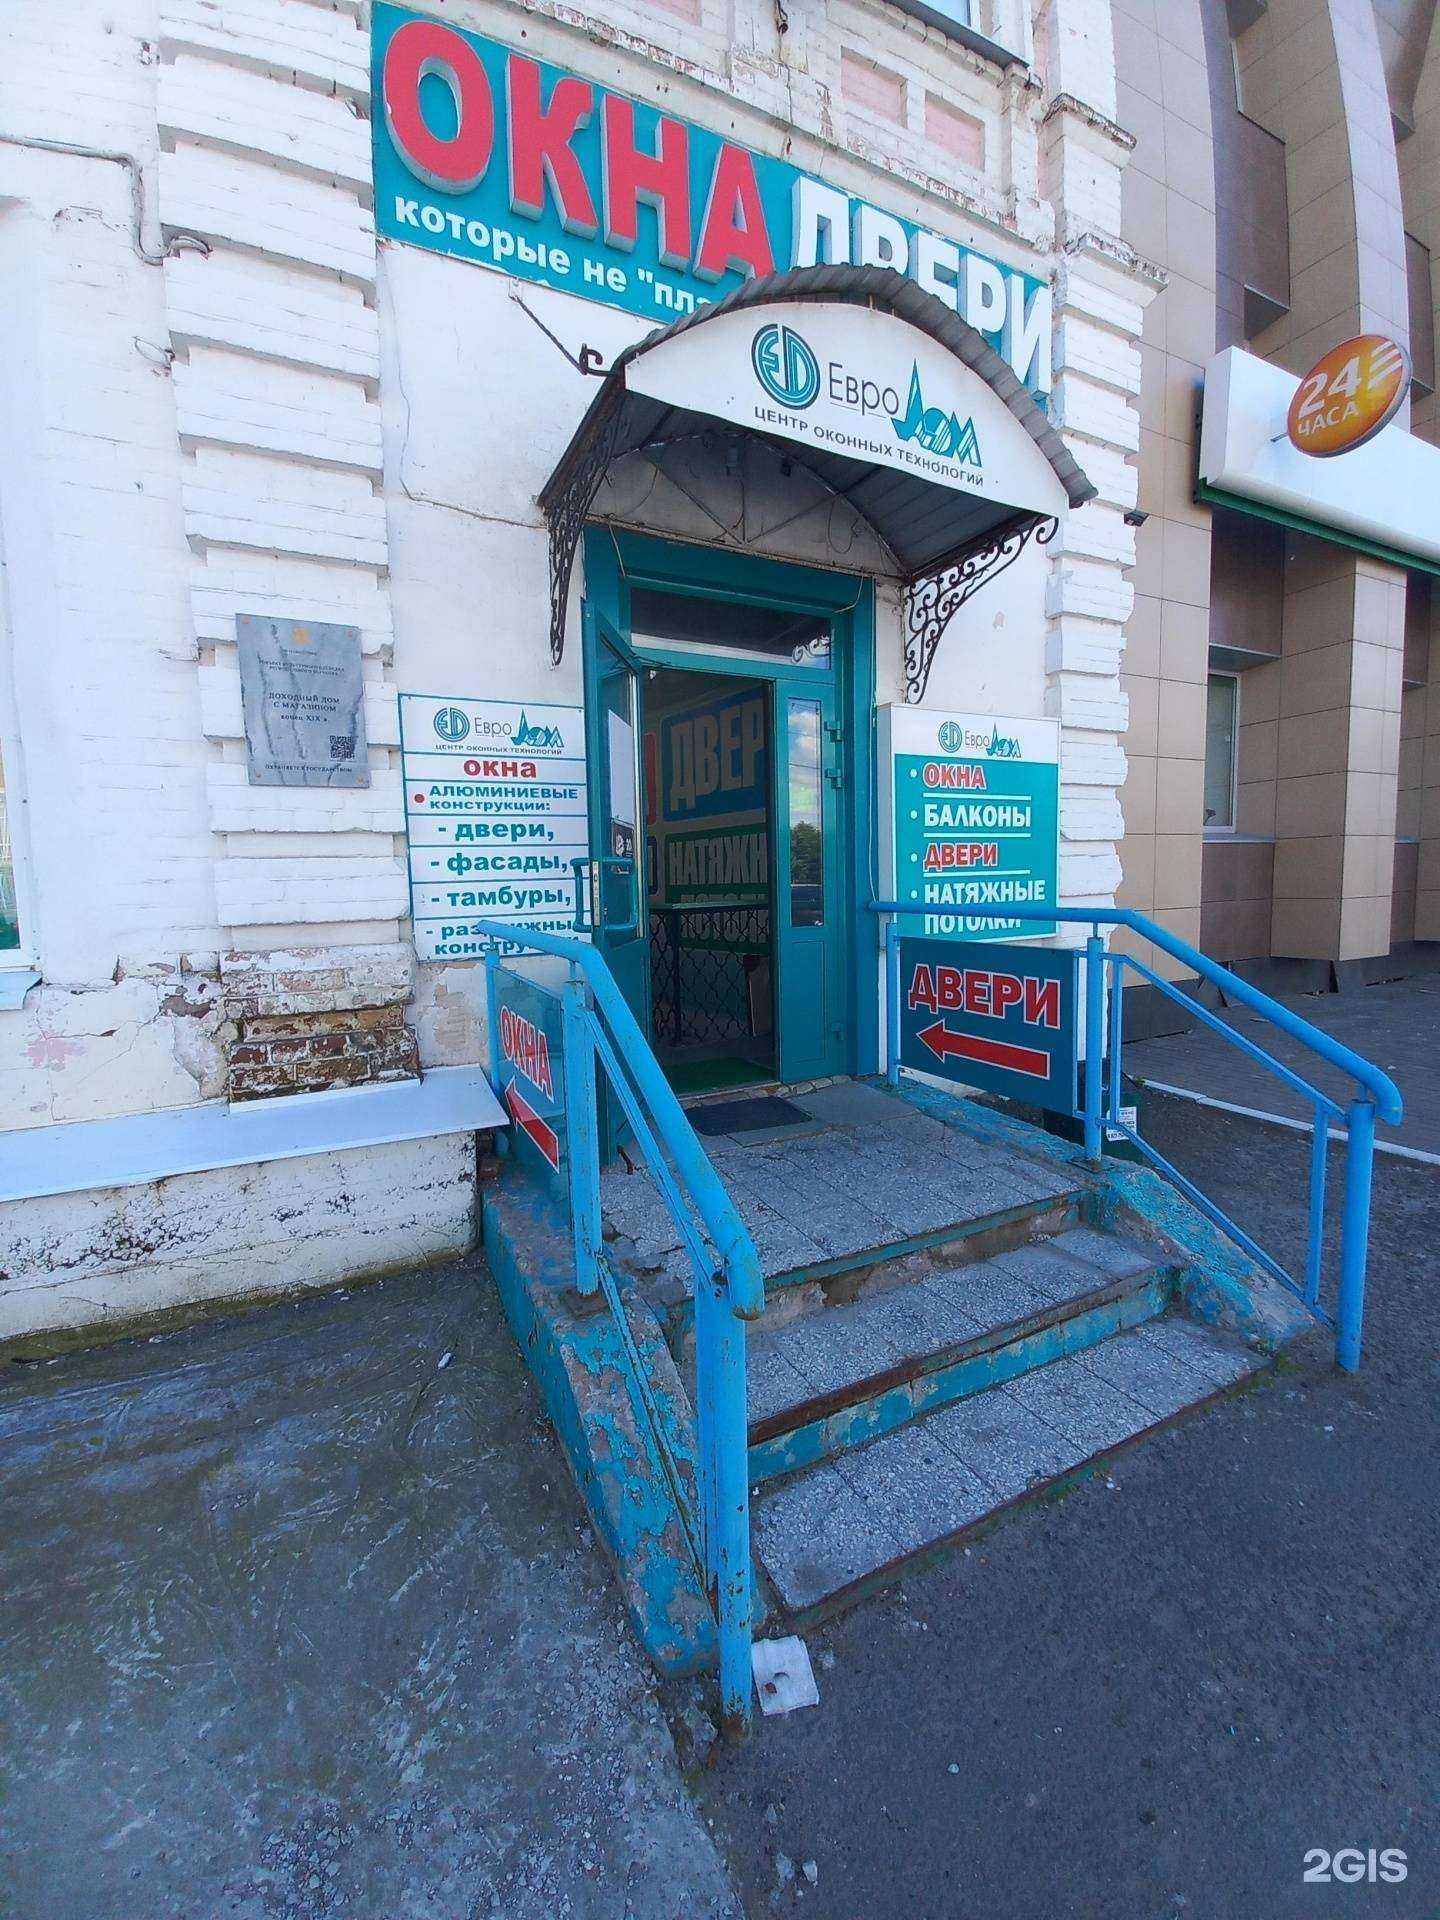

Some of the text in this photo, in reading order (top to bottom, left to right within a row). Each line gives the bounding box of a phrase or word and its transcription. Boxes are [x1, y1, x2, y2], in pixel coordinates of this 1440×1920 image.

[383, 20, 775, 283] ОКНА
[395, 196, 711, 314] которые не "пл
[1297, 356, 1361, 420] 24
[1298, 401, 1360, 436] ЧАСА
[754, 406, 984, 487] ЦЕНТР ОКОННЫХ ТЕХНОЛОГИЙ
[466, 745, 508, 753] ОКОННЫХ
[511, 747, 562, 755] ТЕХНОЛОГИЙ
[670, 699, 766, 812] ДВЕР
[923, 763, 986, 789] ОКНА
[429, 785, 578, 799] АЛЮМИНИЕВЫЕ
[430, 800, 551, 812] конструкции:
[924, 804, 1031, 827] БАЛКОНЫ
[455, 823, 554, 842] двери,
[446, 853, 567, 875] фасады,
[669, 833, 768, 885] НАТЯЖН
[923, 843, 998, 871] ДВЕРИ
[446, 885, 571, 908] тамбуры,
[924, 880, 1045, 904] НАТЯЖНЫЕ
[441, 919, 572, 940] разжны
[908, 963, 1061, 1030] ДВЕРИ
[500, 1005, 555, 1104] ОКНА
